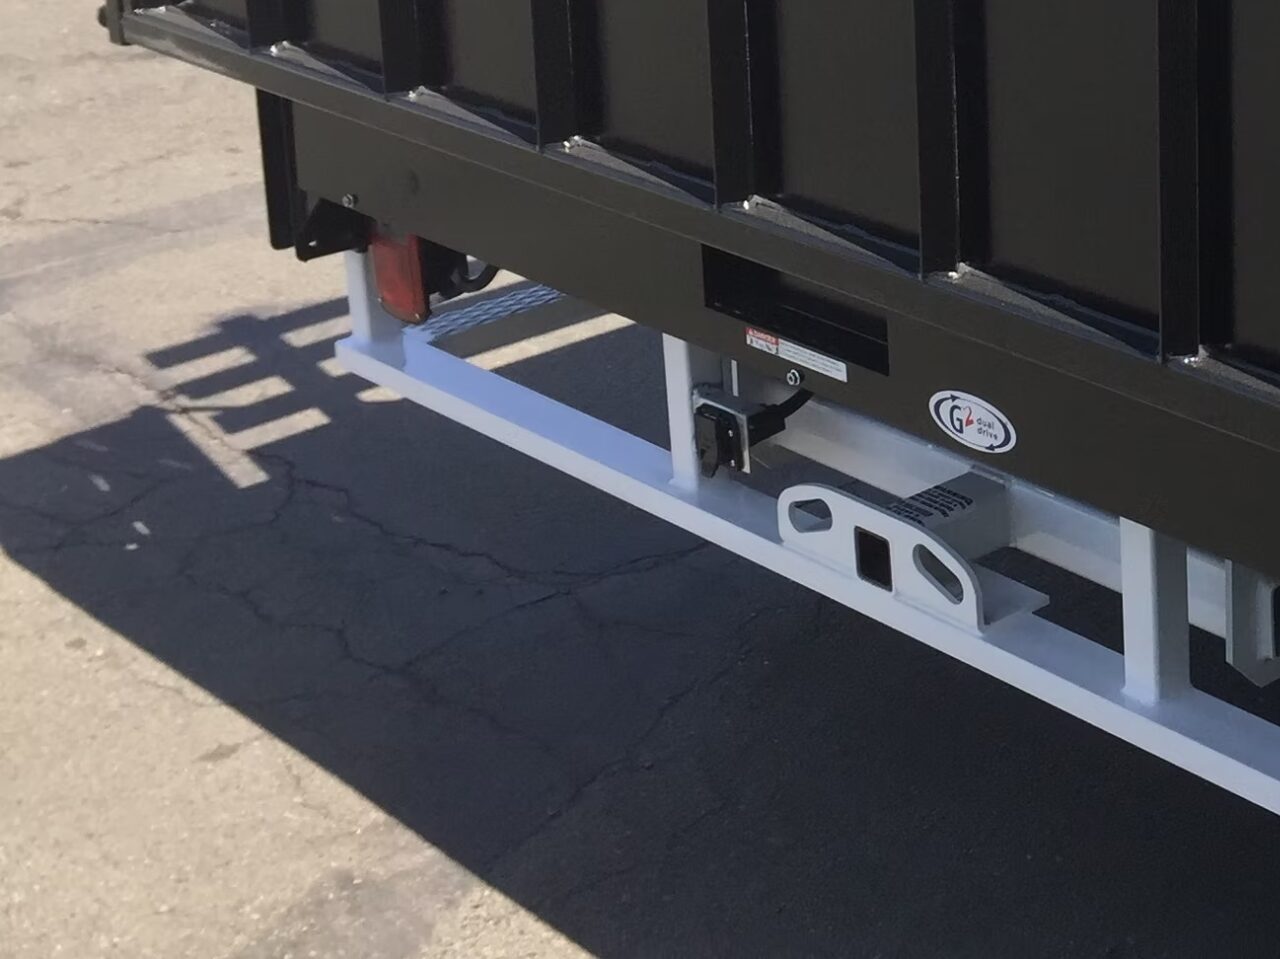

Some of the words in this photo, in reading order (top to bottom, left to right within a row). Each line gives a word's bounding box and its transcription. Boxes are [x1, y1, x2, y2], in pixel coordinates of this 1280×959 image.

[949, 404, 974, 434] G2
[977, 417, 995, 430] dual
[977, 427, 999, 441] drive
